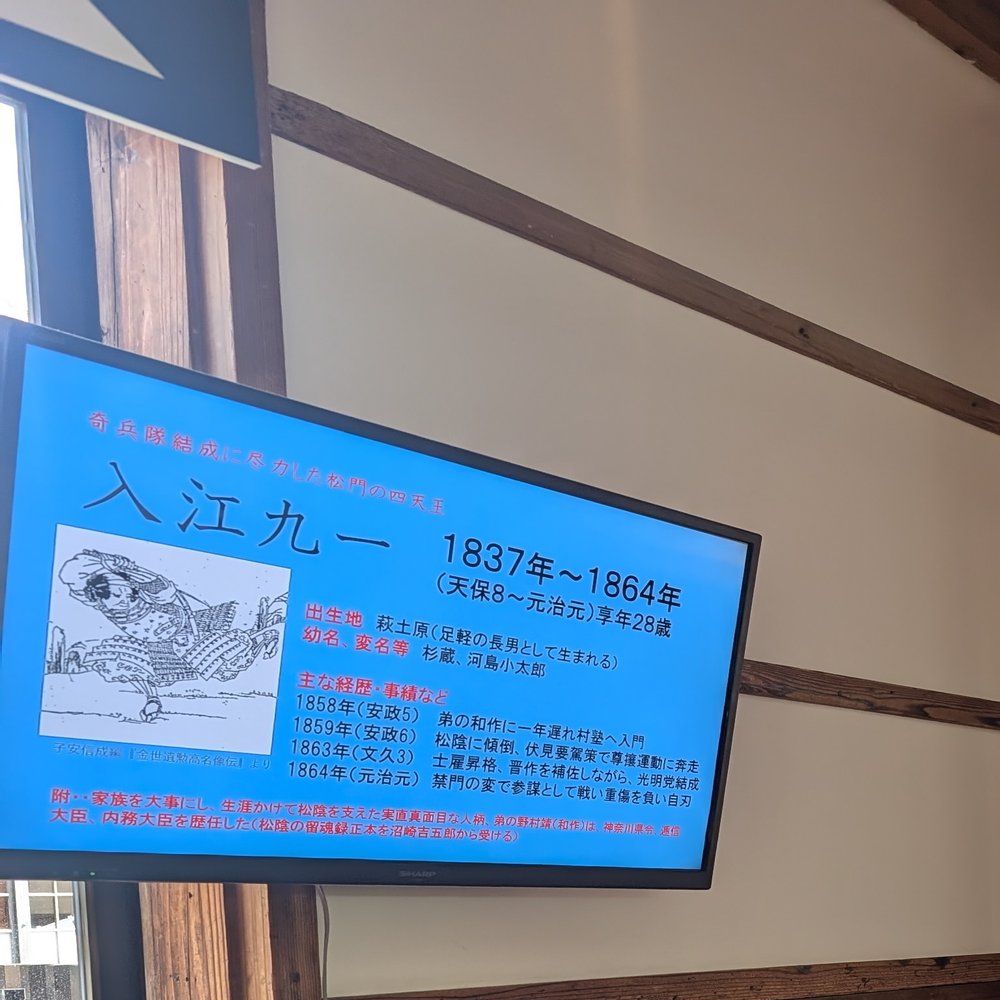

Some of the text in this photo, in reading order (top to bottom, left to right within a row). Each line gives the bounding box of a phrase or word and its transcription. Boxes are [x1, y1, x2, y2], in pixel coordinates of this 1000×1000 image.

[88, 411, 445, 515] 奇兵隊結成に尽力した松門の四天王
[83, 461, 391, 555] 入江九一
[443, 533, 682, 613] 1837年～1864年
[304, 603, 364, 628] 出生地
[301, 625, 546, 678] 幼名、変名等 杉蔵、河島小太郎
[297, 671, 449, 705] 主な経歴・事績など
[293, 716, 417, 745] 1859年（安政6）
[296, 693, 645, 750] 1858年（安政5） 弟の和作に一年遅れ村塾へ入門
[290, 739, 414, 767] 1863年（文久3）
[288, 761, 420, 788] 1864年（元治元）
[400, 870, 437, 878] SHARP
